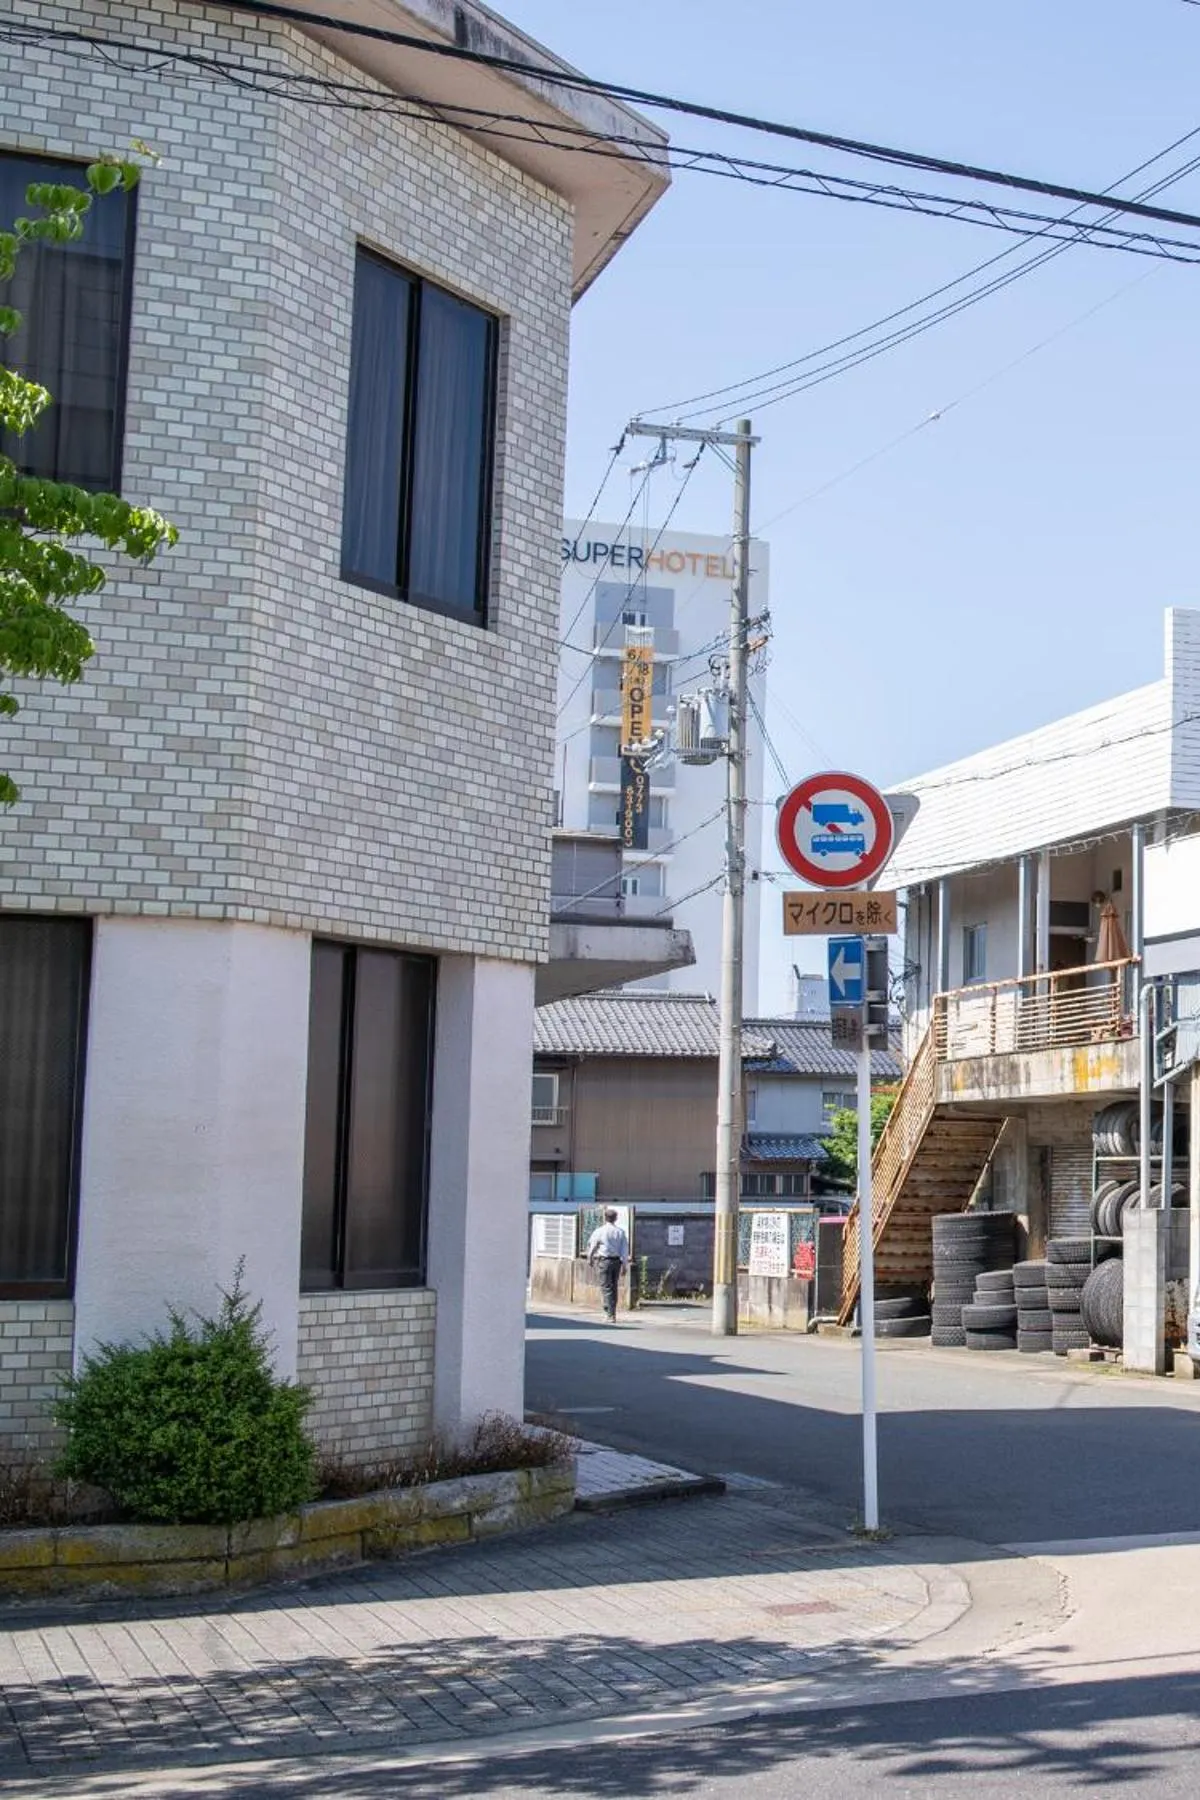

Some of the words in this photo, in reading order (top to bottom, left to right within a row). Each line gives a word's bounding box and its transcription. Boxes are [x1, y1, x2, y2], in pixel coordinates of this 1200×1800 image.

[788, 900, 892, 926] マイクロを除く
